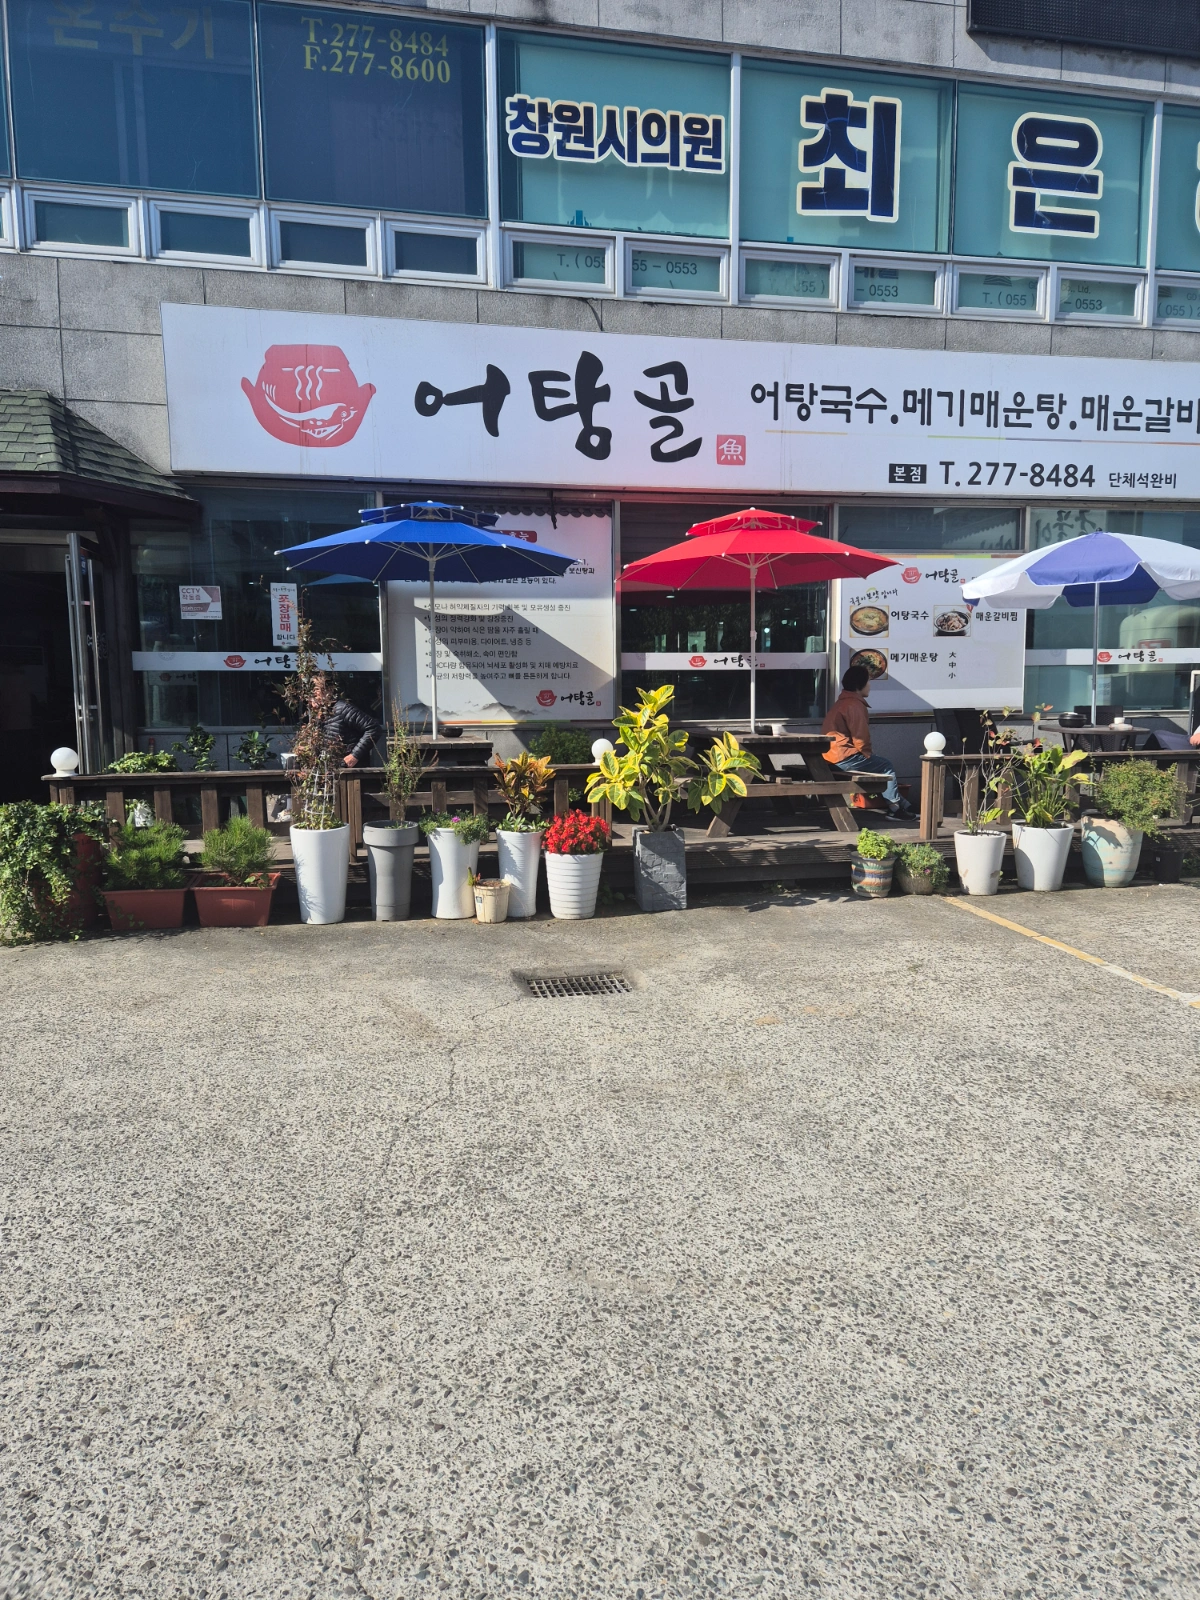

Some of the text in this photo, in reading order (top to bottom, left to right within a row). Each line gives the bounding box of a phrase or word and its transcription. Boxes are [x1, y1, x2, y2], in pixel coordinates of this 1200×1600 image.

[301, 15, 449, 57] T.277-8484
[303, 44, 450, 83] F.277-8600
[507, 95, 724, 173] 창원시의원
[798, 88, 900, 222] 최
[1008, 112, 1102, 237] 은
[1077, 284, 1091, 294] Ltd.
[414, 350, 702, 463] 어탕골
[893, 461, 1177, 489] 본점 T.277-8484 단체석완비
[925, 568, 959, 583] 어탕골
[450, 603, 490, 611] 허약체질자의
[492, 603, 505, 612] 기력
[558, 604, 571, 612] 증진
[278, 594, 292, 633] 포장판매
[450, 614, 477, 623] 정력강화
[487, 615, 514, 623] 강장증진
[890, 610, 1018, 622] 어탕국수 매운갈비찜
[450, 626, 471, 634] 약하여
[472, 626, 486, 634] 식은
[487, 626, 501, 635] 땀을
[502, 626, 516, 634] 자주
[276, 633, 296, 641] 합니다
[510, 638, 524, 646] 냉증
[483, 650, 496, 658] 속이
[498, 650, 518, 659] 편안함
[890, 652, 939, 663] 메기매운탕
[948, 651, 957, 659] 大
[1118, 650, 1158, 663] 어탕골
[459, 661, 485, 669] 함유되어
[487, 661, 507, 669] 뇌세포
[509, 661, 528, 669] 활성화
[538, 661, 551, 669] 치매
[552, 661, 579, 669] 예방치료
[948, 661, 957, 669] 中
[452, 672, 478, 680] 저항력을
[480, 672, 507, 680] 높여주고
[508, 672, 521, 680] 뼈를
[523, 672, 549, 680] 튼튼하게
[948, 672, 957, 680] 小
[560, 690, 595, 706] 어탕골
